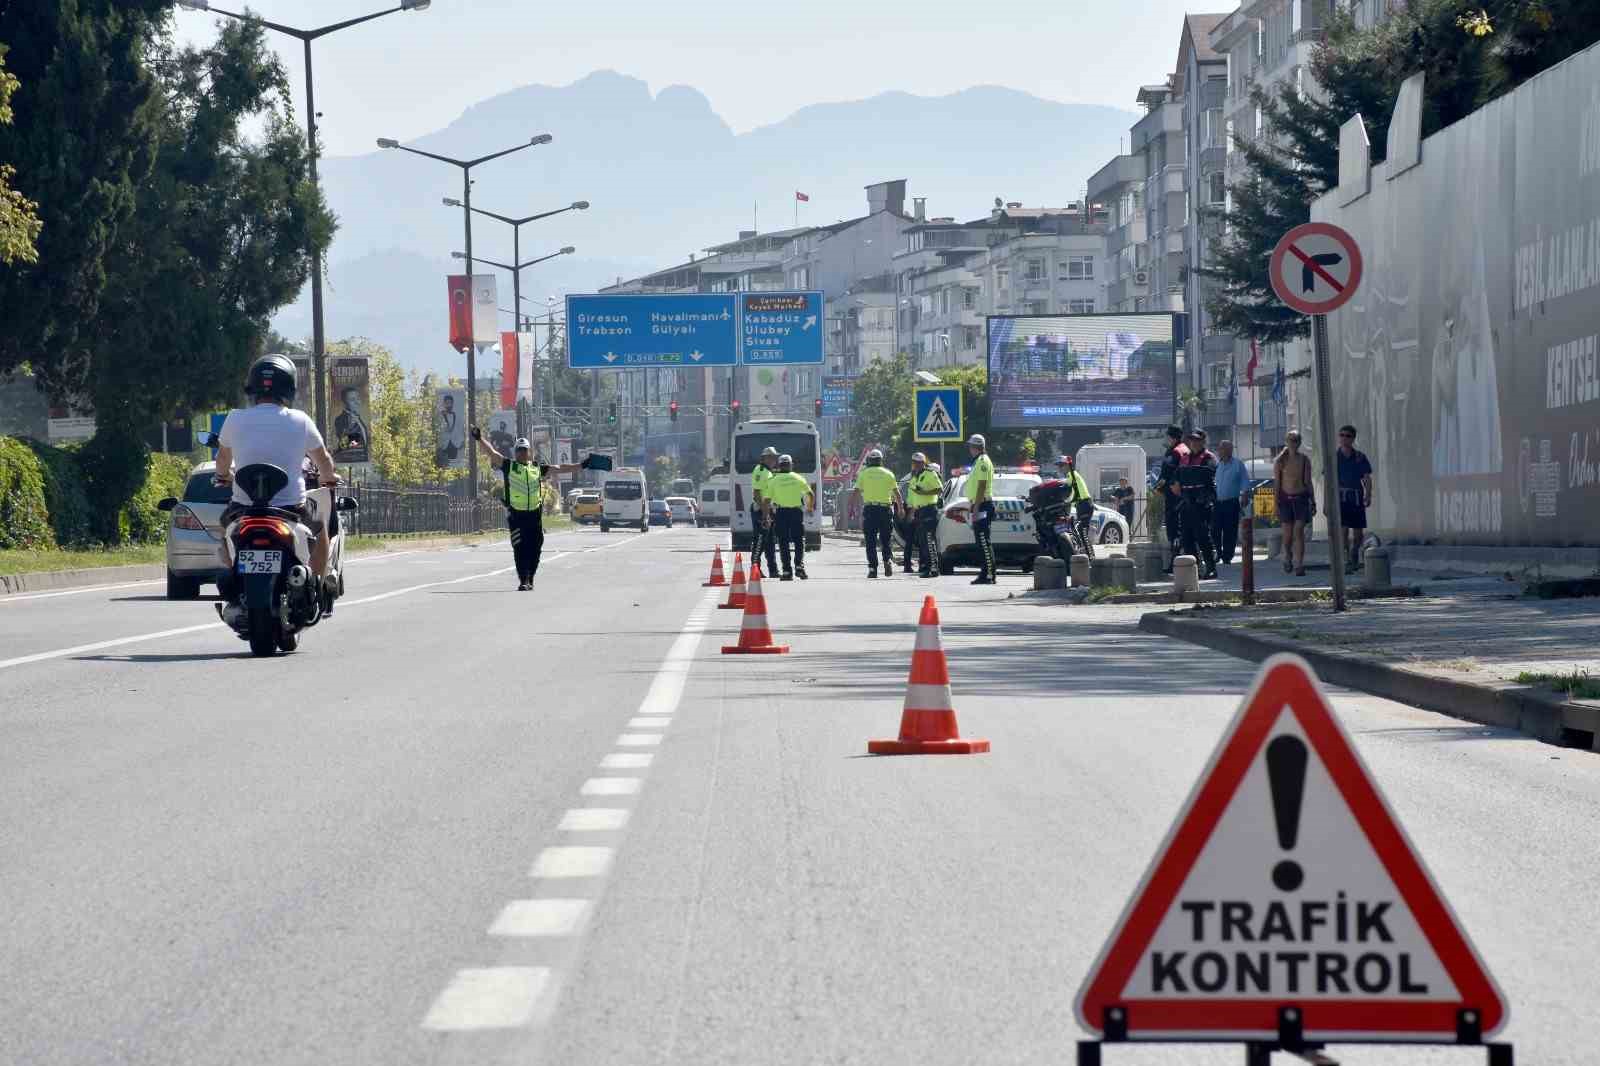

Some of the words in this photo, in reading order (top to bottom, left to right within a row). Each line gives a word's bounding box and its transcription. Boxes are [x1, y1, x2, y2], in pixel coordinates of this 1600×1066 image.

[577, 313, 628, 323] Giresun
[651, 312, 719, 322] Havalimanı
[745, 312, 800, 324] Kabadüz
[578, 325, 632, 335] Trabzon
[651, 324, 696, 336] Gülyalı
[745, 325, 791, 336] Ulubey
[745, 336, 780, 346] Sivas
[1546, 333, 1600, 408] KENTSEL
[239, 551, 255, 562] 52
[264, 551, 281, 562] ER
[250, 561, 273, 572] 752
[1181, 891, 1393, 943] TRAFİK
[1151, 951, 1429, 995] KONTROL
